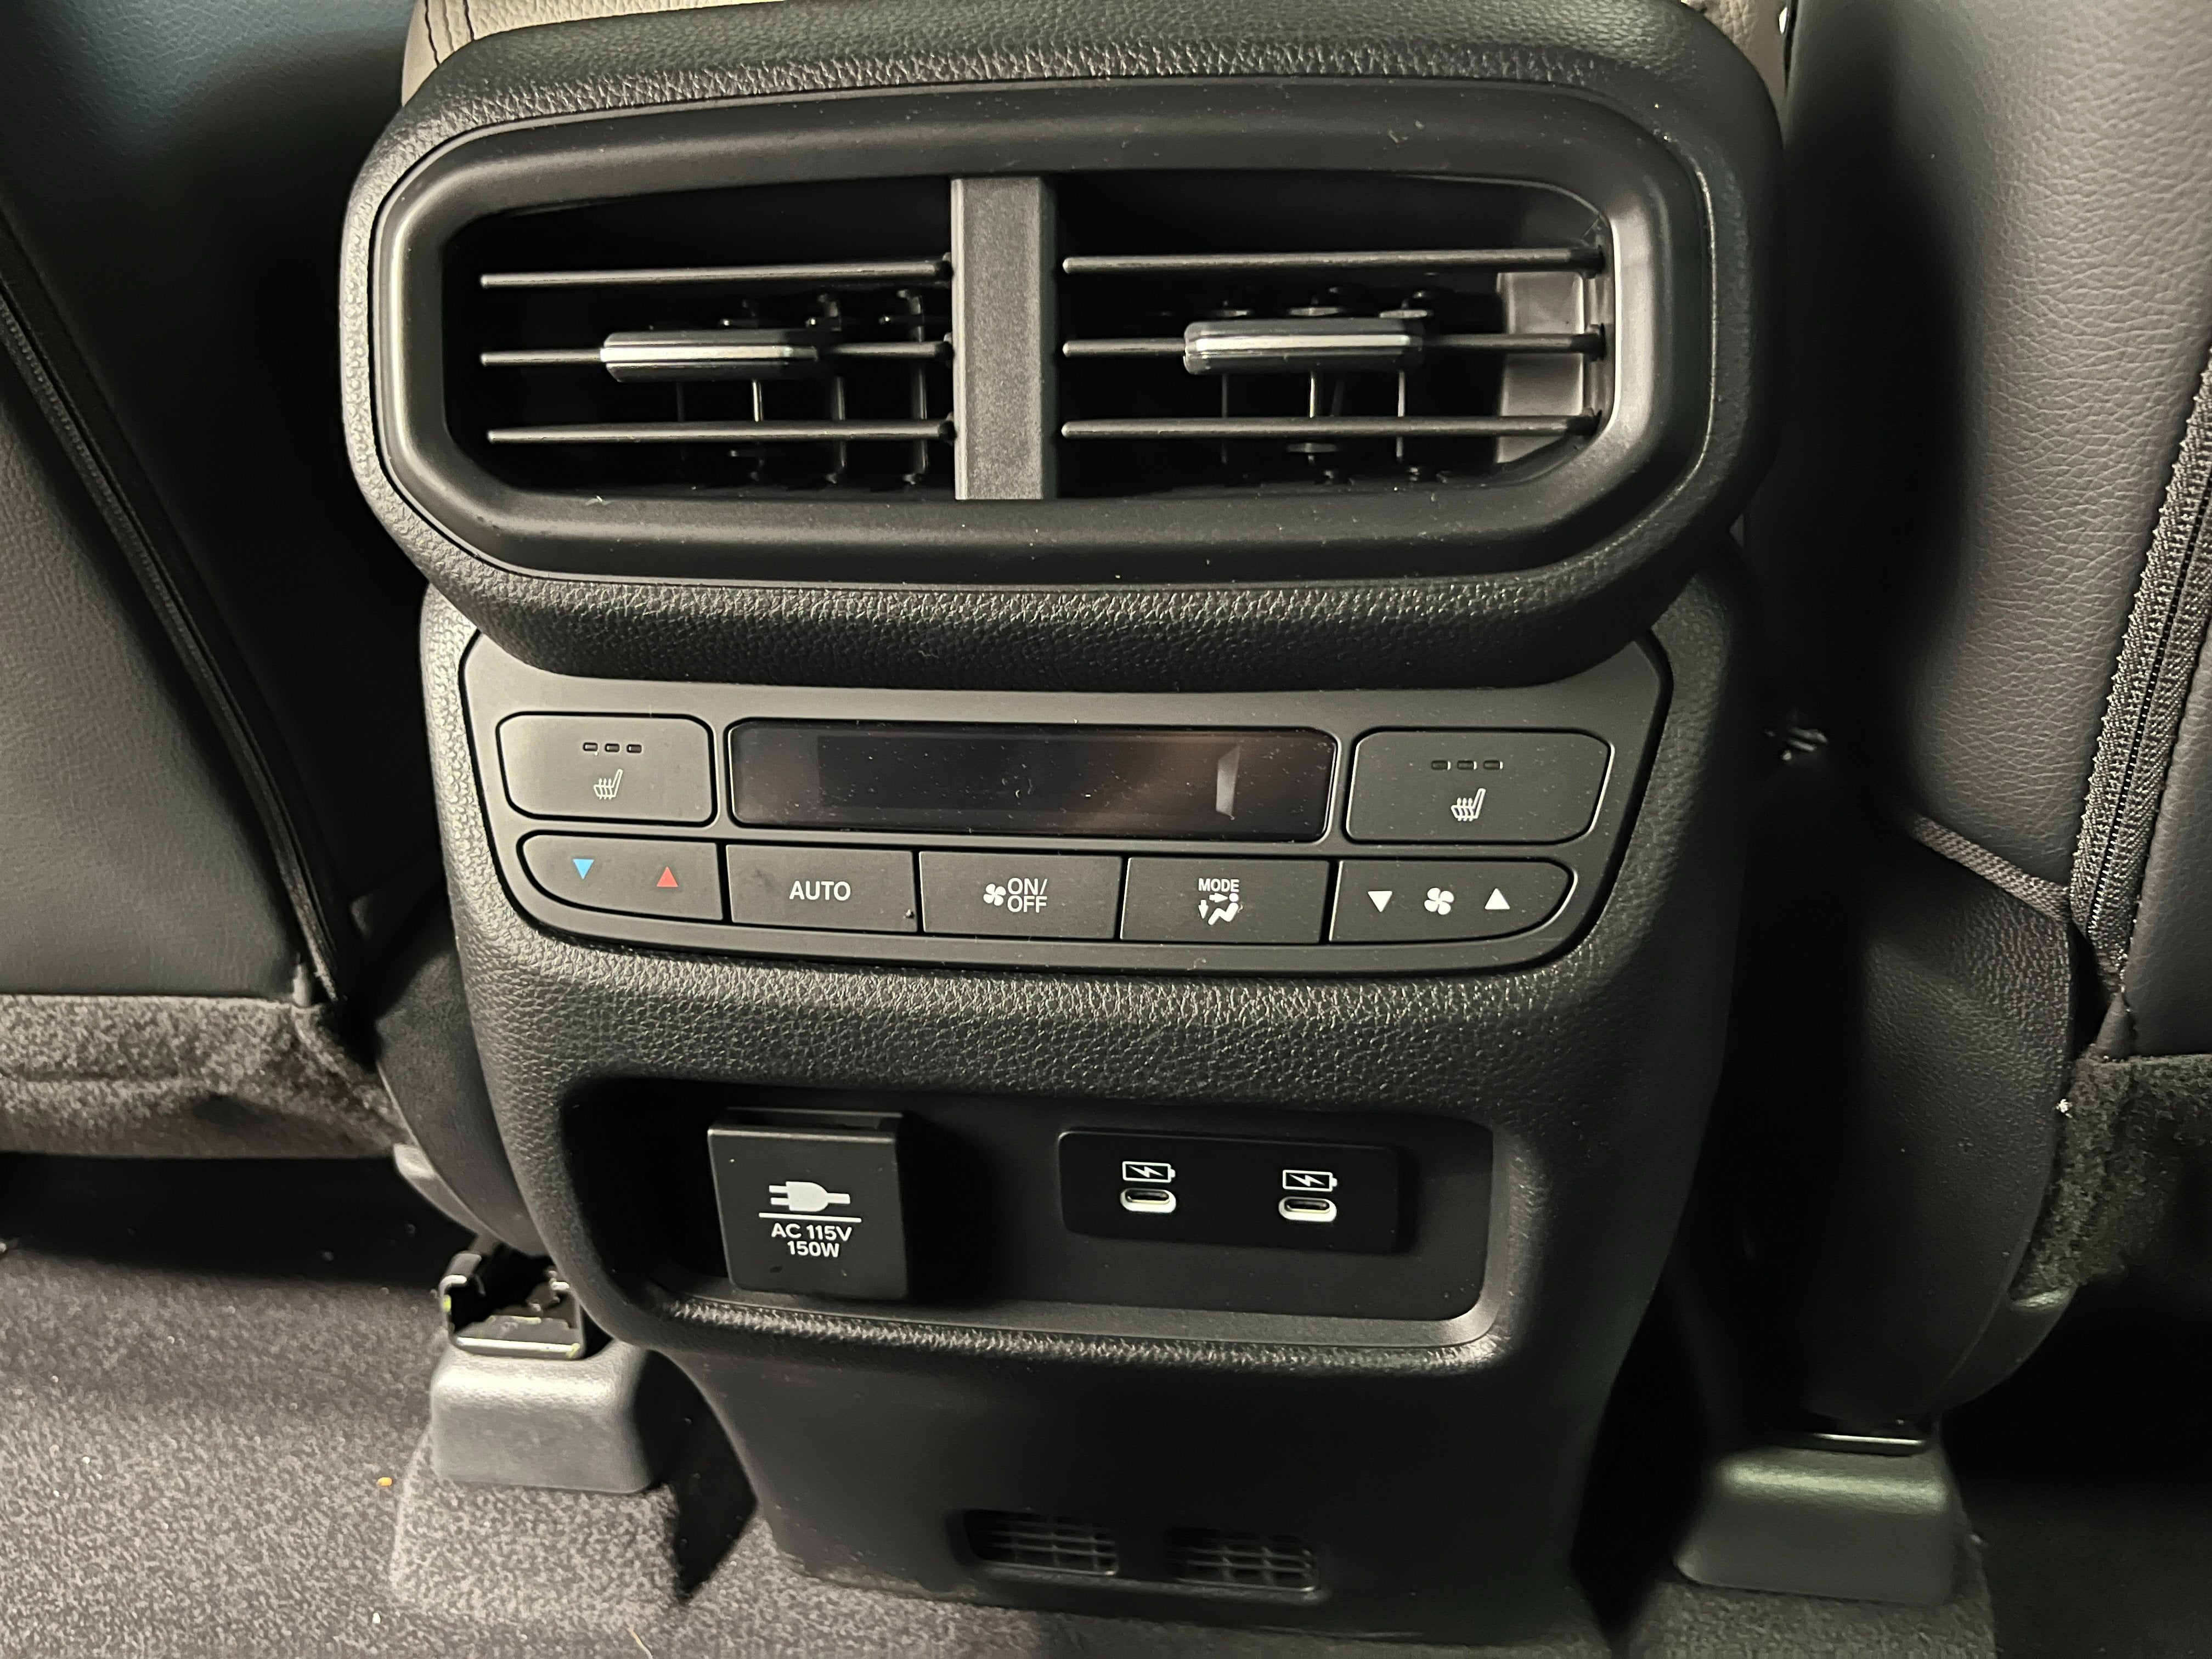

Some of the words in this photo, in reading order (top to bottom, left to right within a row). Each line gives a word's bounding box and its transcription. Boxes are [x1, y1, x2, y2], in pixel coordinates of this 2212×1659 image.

[789, 880, 851, 901] AUTO
[1007, 877, 1048, 895] ON/
[1198, 878, 1240, 893] MODE
[1007, 895, 1047, 913] OFF
[771, 1222, 802, 1239] AC
[806, 1224, 853, 1242] 115V
[787, 1240, 839, 1257] 150W
